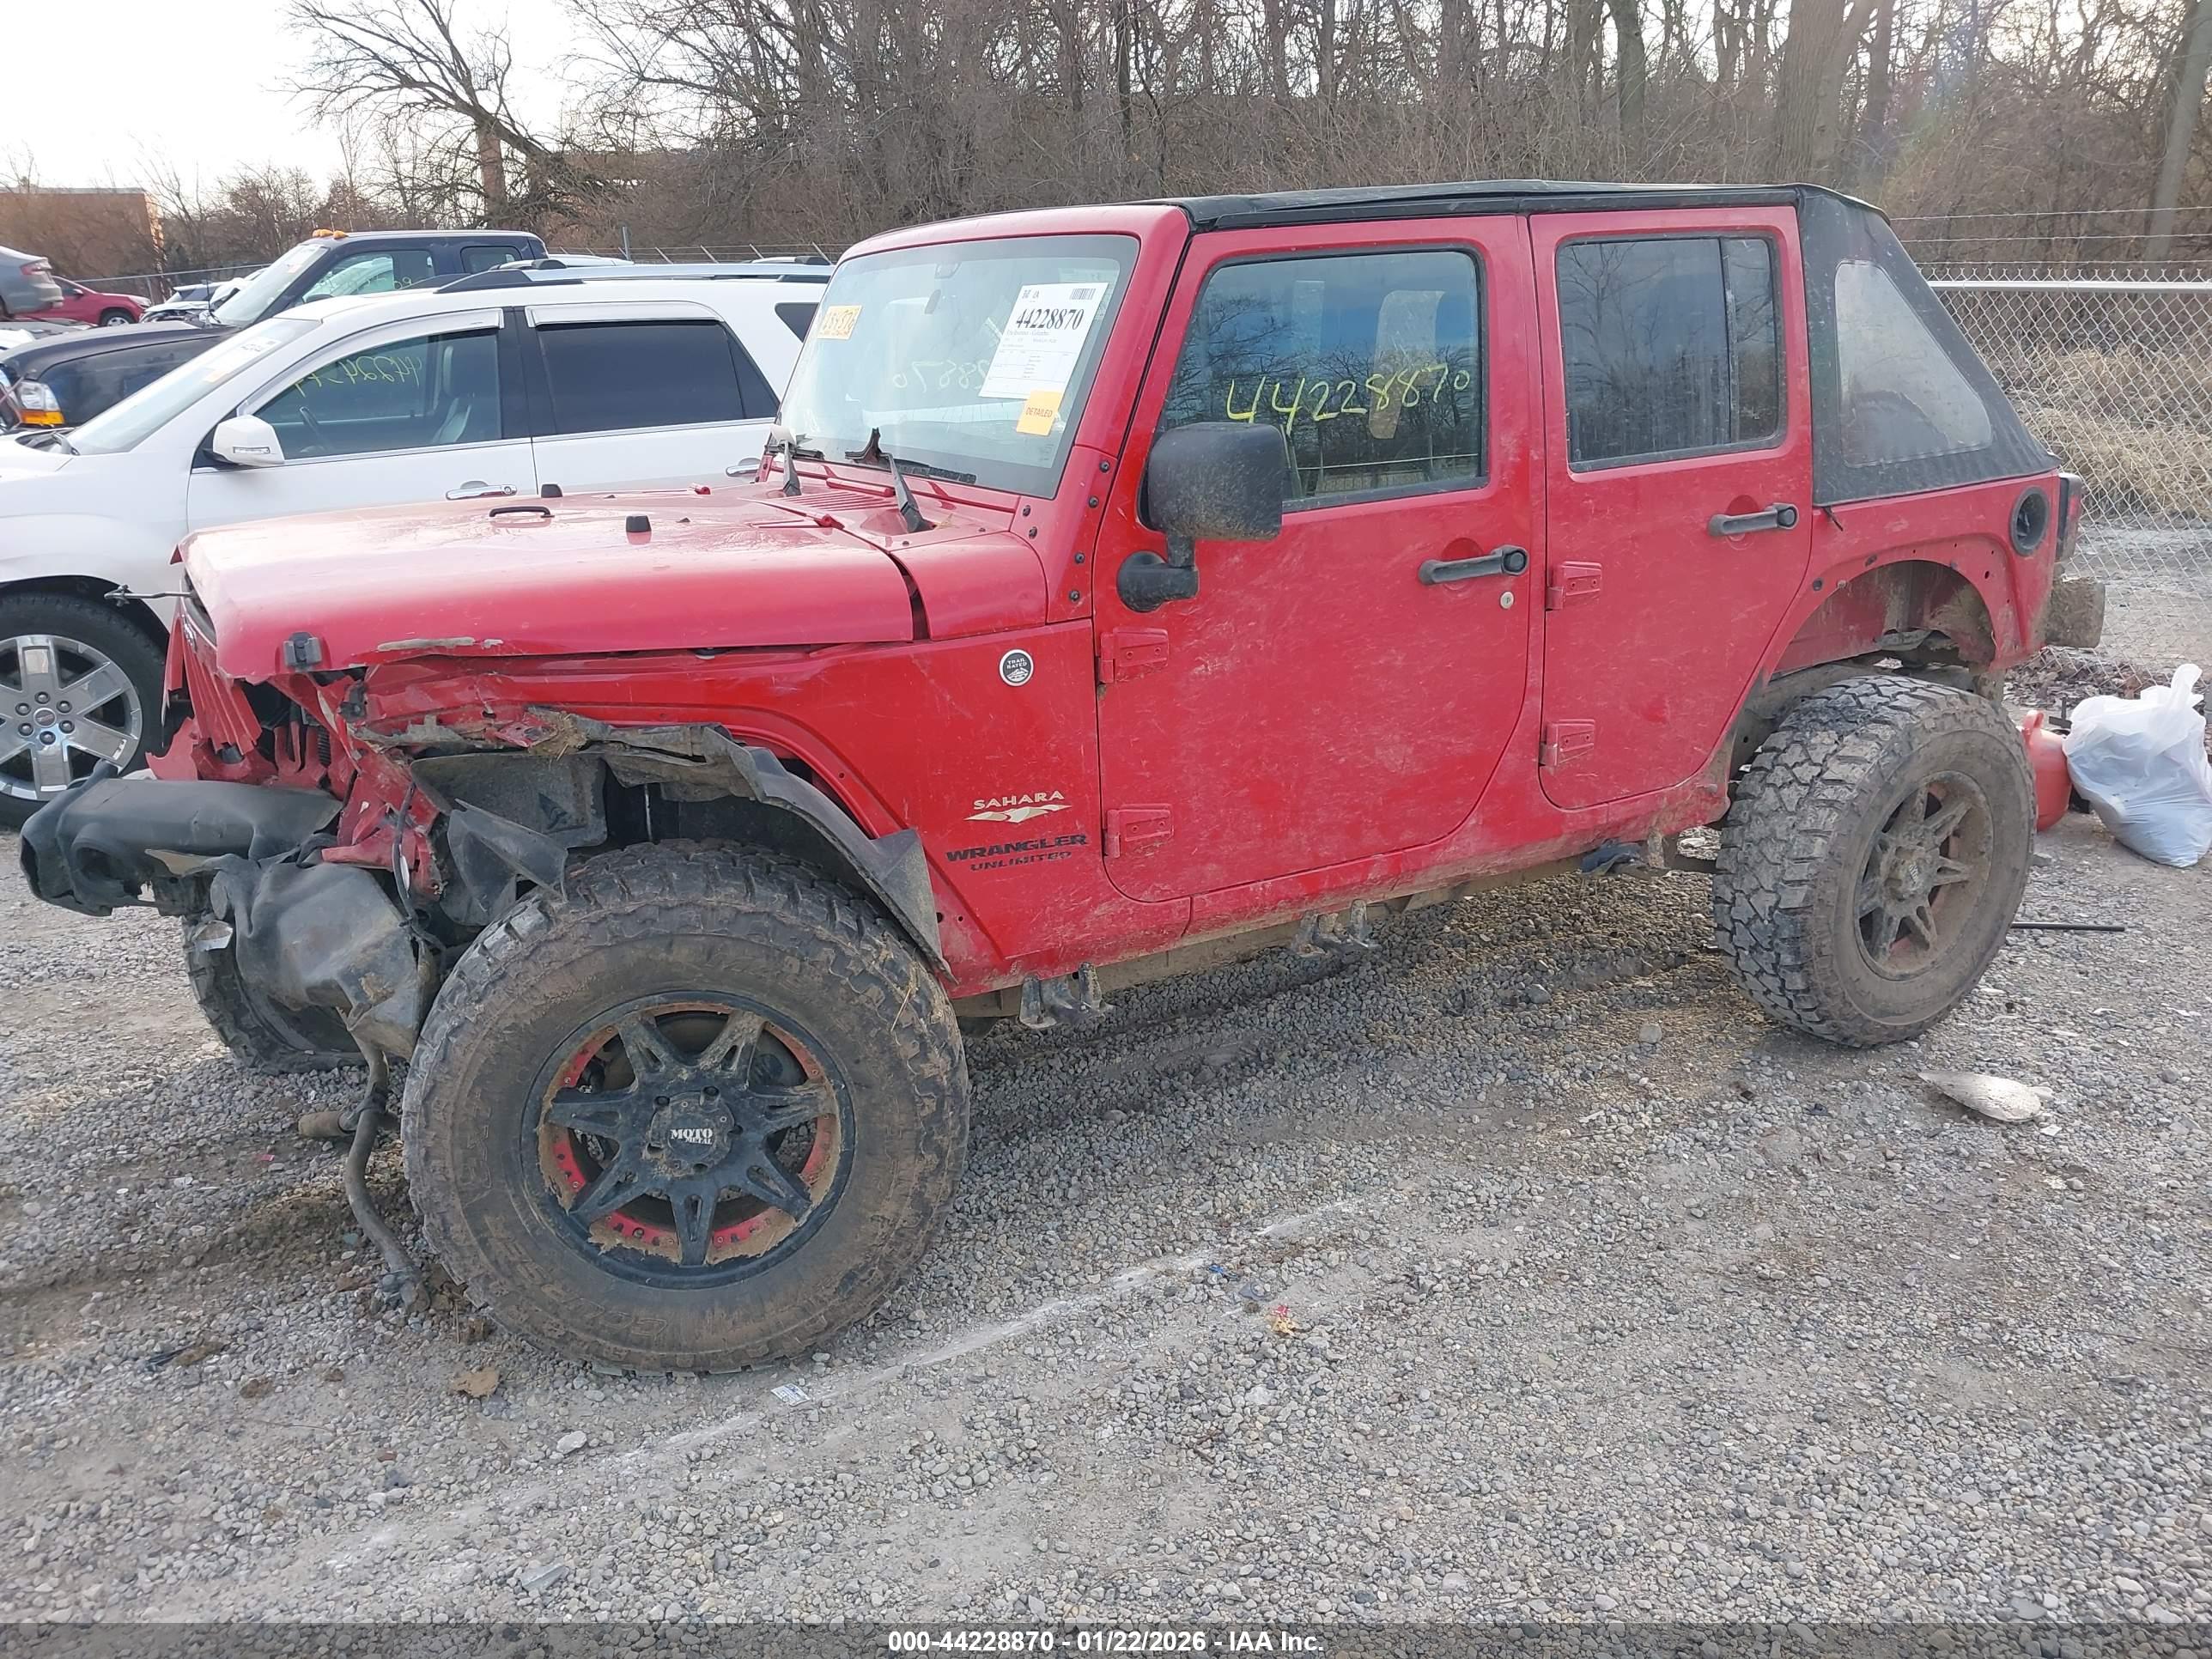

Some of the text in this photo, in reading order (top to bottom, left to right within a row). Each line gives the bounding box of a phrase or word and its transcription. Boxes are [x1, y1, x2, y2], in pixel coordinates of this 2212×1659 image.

[1016, 308, 1084, 330] 44228870
[1226, 362, 1470, 437] 44228870
[1026, 407, 1053, 417] DETAILED
[973, 790, 1065, 810] SAHARA
[946, 834, 1088, 863] WRANGLER
[970, 851, 1073, 872] UNLIMITED
[670, 1127, 714, 1139] MOTO
